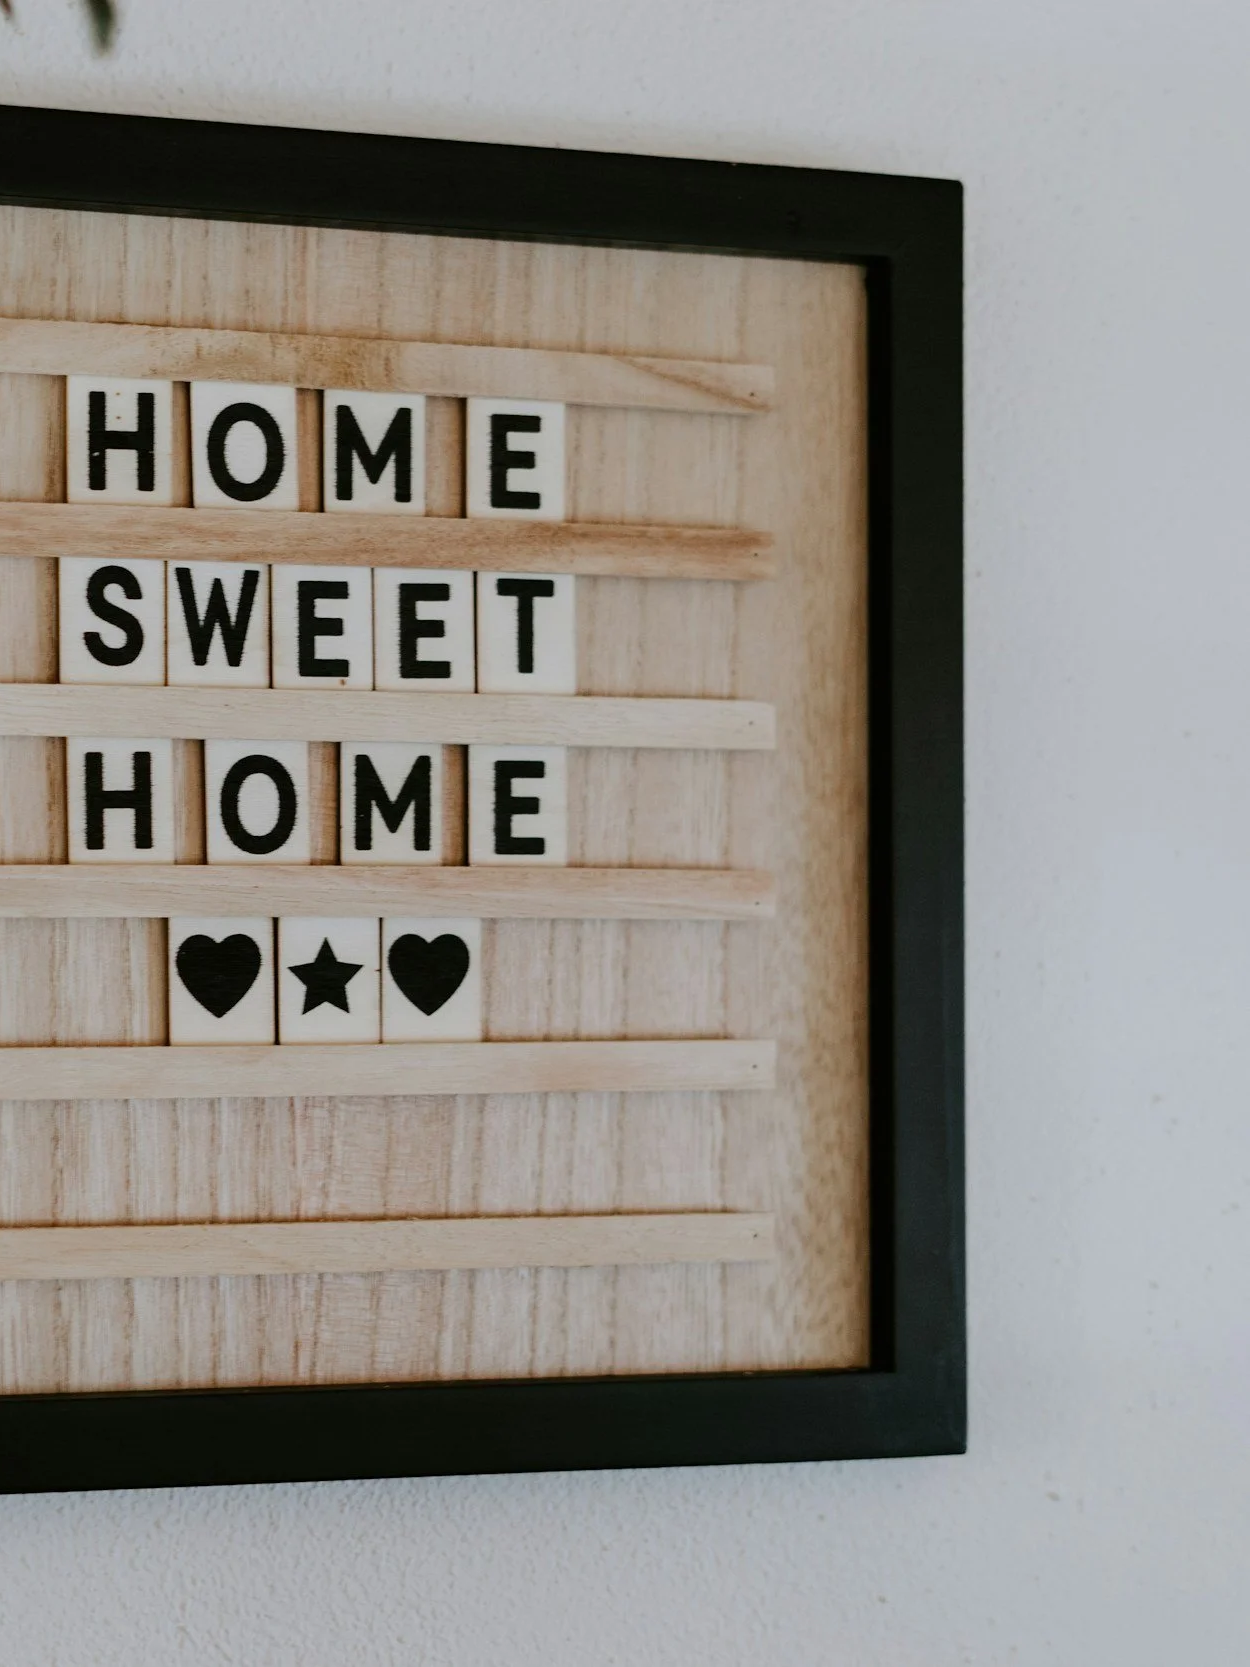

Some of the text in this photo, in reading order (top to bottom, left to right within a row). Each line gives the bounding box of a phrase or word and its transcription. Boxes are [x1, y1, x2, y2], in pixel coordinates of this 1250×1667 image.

[87, 390, 542, 510] HOME
[83, 564, 555, 679] SWEET
[84, 751, 546, 856] HOME
